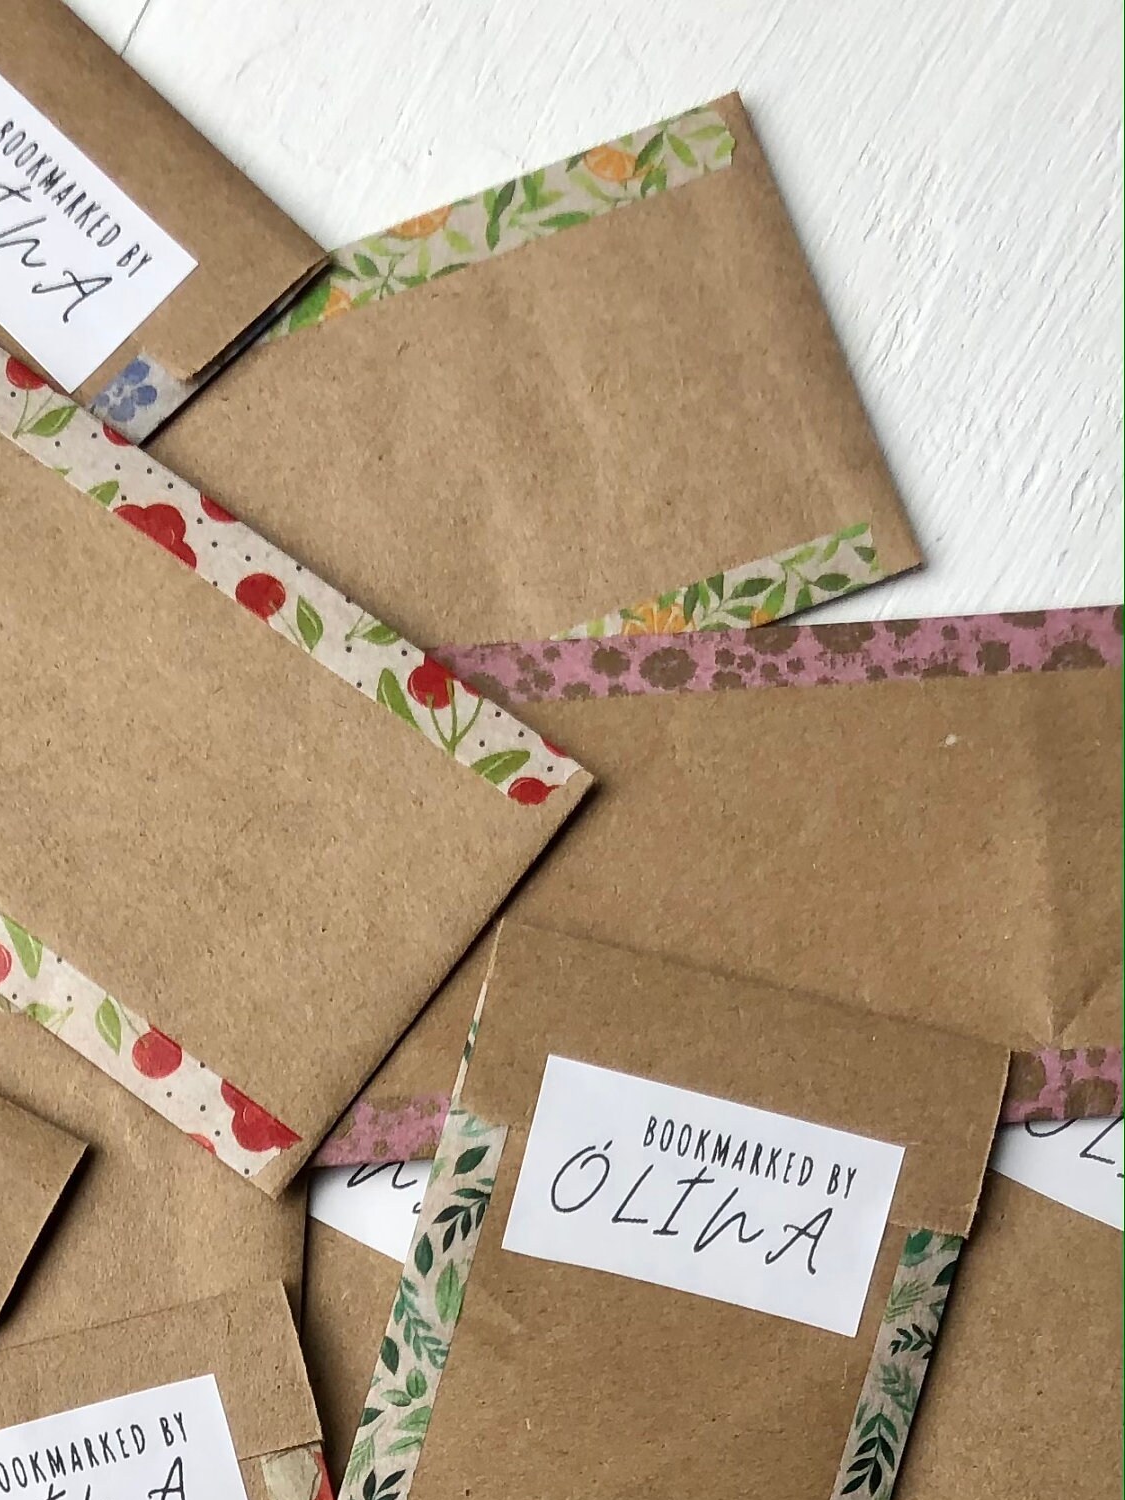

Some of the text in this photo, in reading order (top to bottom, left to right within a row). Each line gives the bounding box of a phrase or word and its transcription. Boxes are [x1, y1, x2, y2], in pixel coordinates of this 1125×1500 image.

[117, 242, 153, 278] BY
[643, 1116, 857, 1199] BOOKMARKED BY
[160, 1412, 188, 1448] BY
